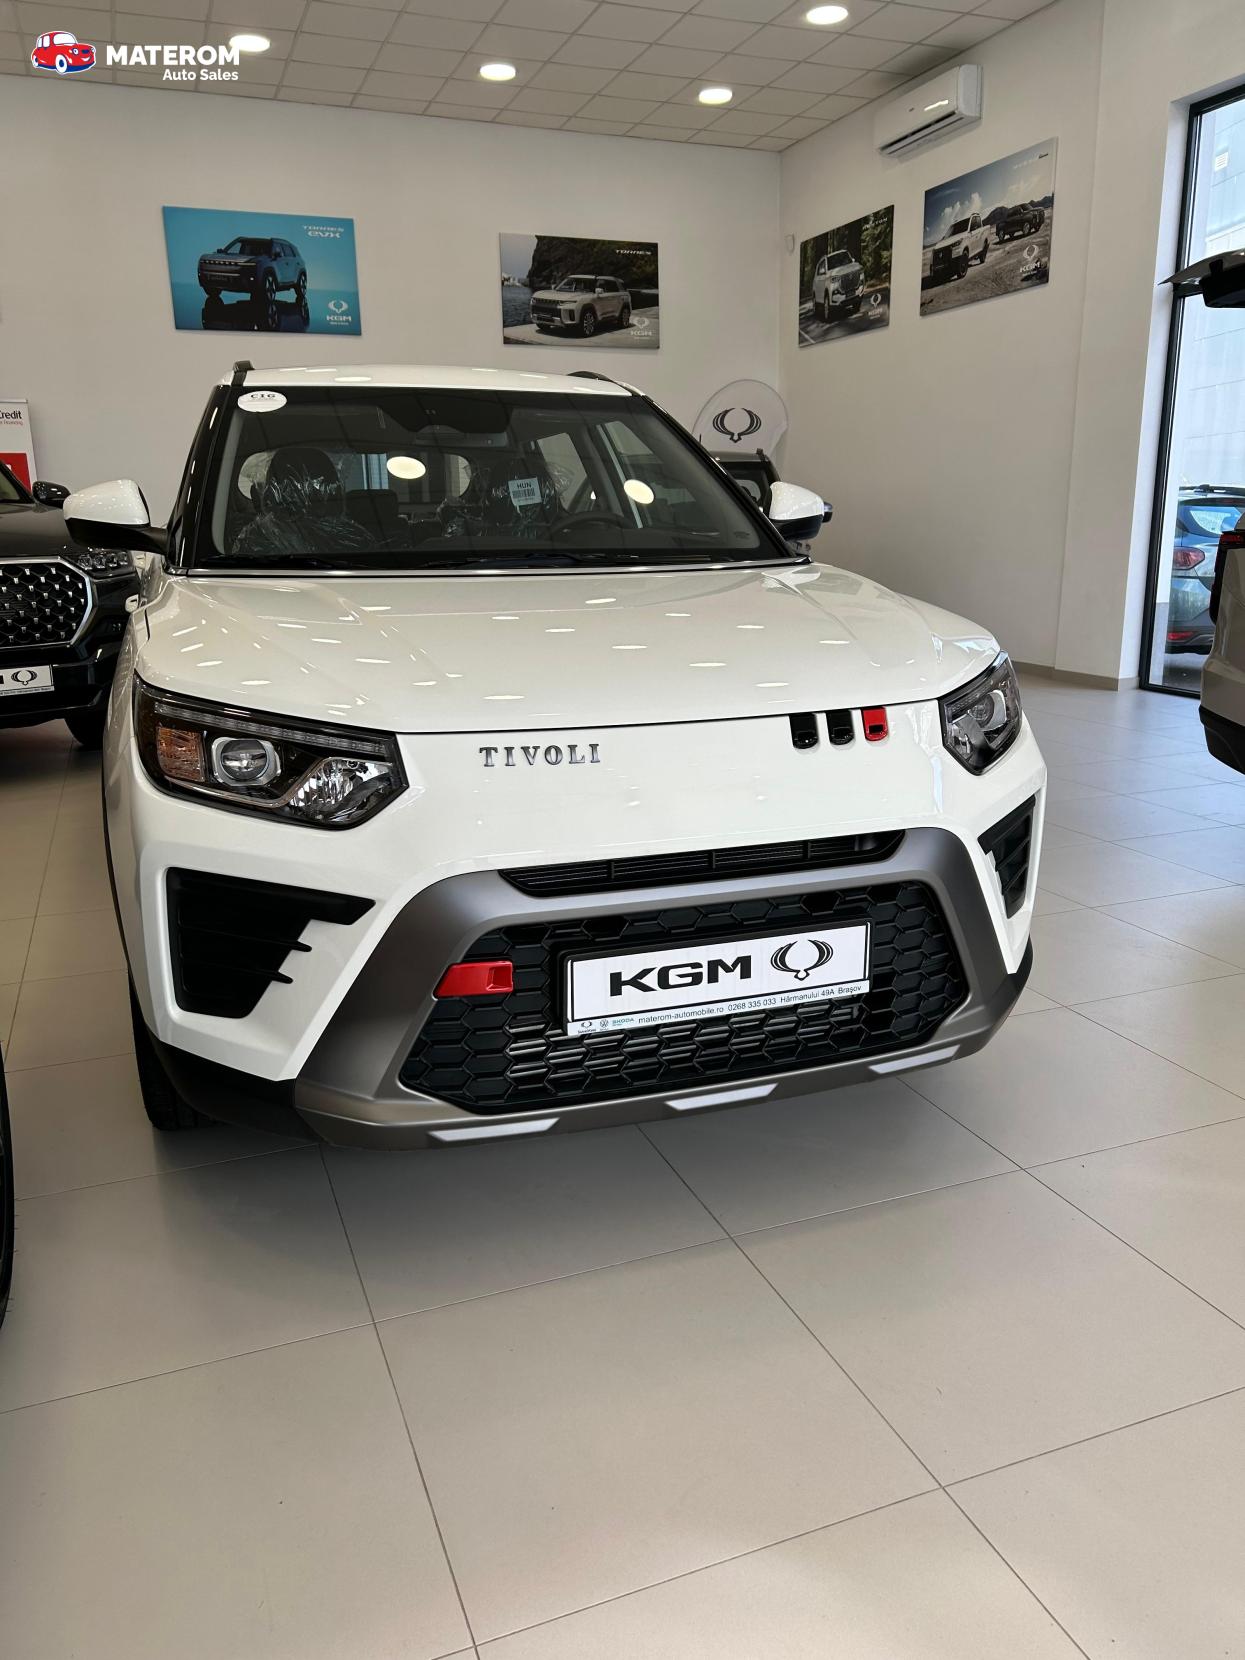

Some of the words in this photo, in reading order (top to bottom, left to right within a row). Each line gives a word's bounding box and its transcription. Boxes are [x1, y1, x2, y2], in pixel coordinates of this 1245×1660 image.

[326, 314, 352, 322] KGM
[479, 743, 601, 767] TIVOLI
[609, 954, 752, 997] KGM
[638, 1006, 724, 1024] materom-automobile.ro
[727, 1002, 747, 1012] 0268
[748, 999, 762, 1009] 335
[763, 997, 777, 1007] 033
[820, 988, 835, 997] 49A
